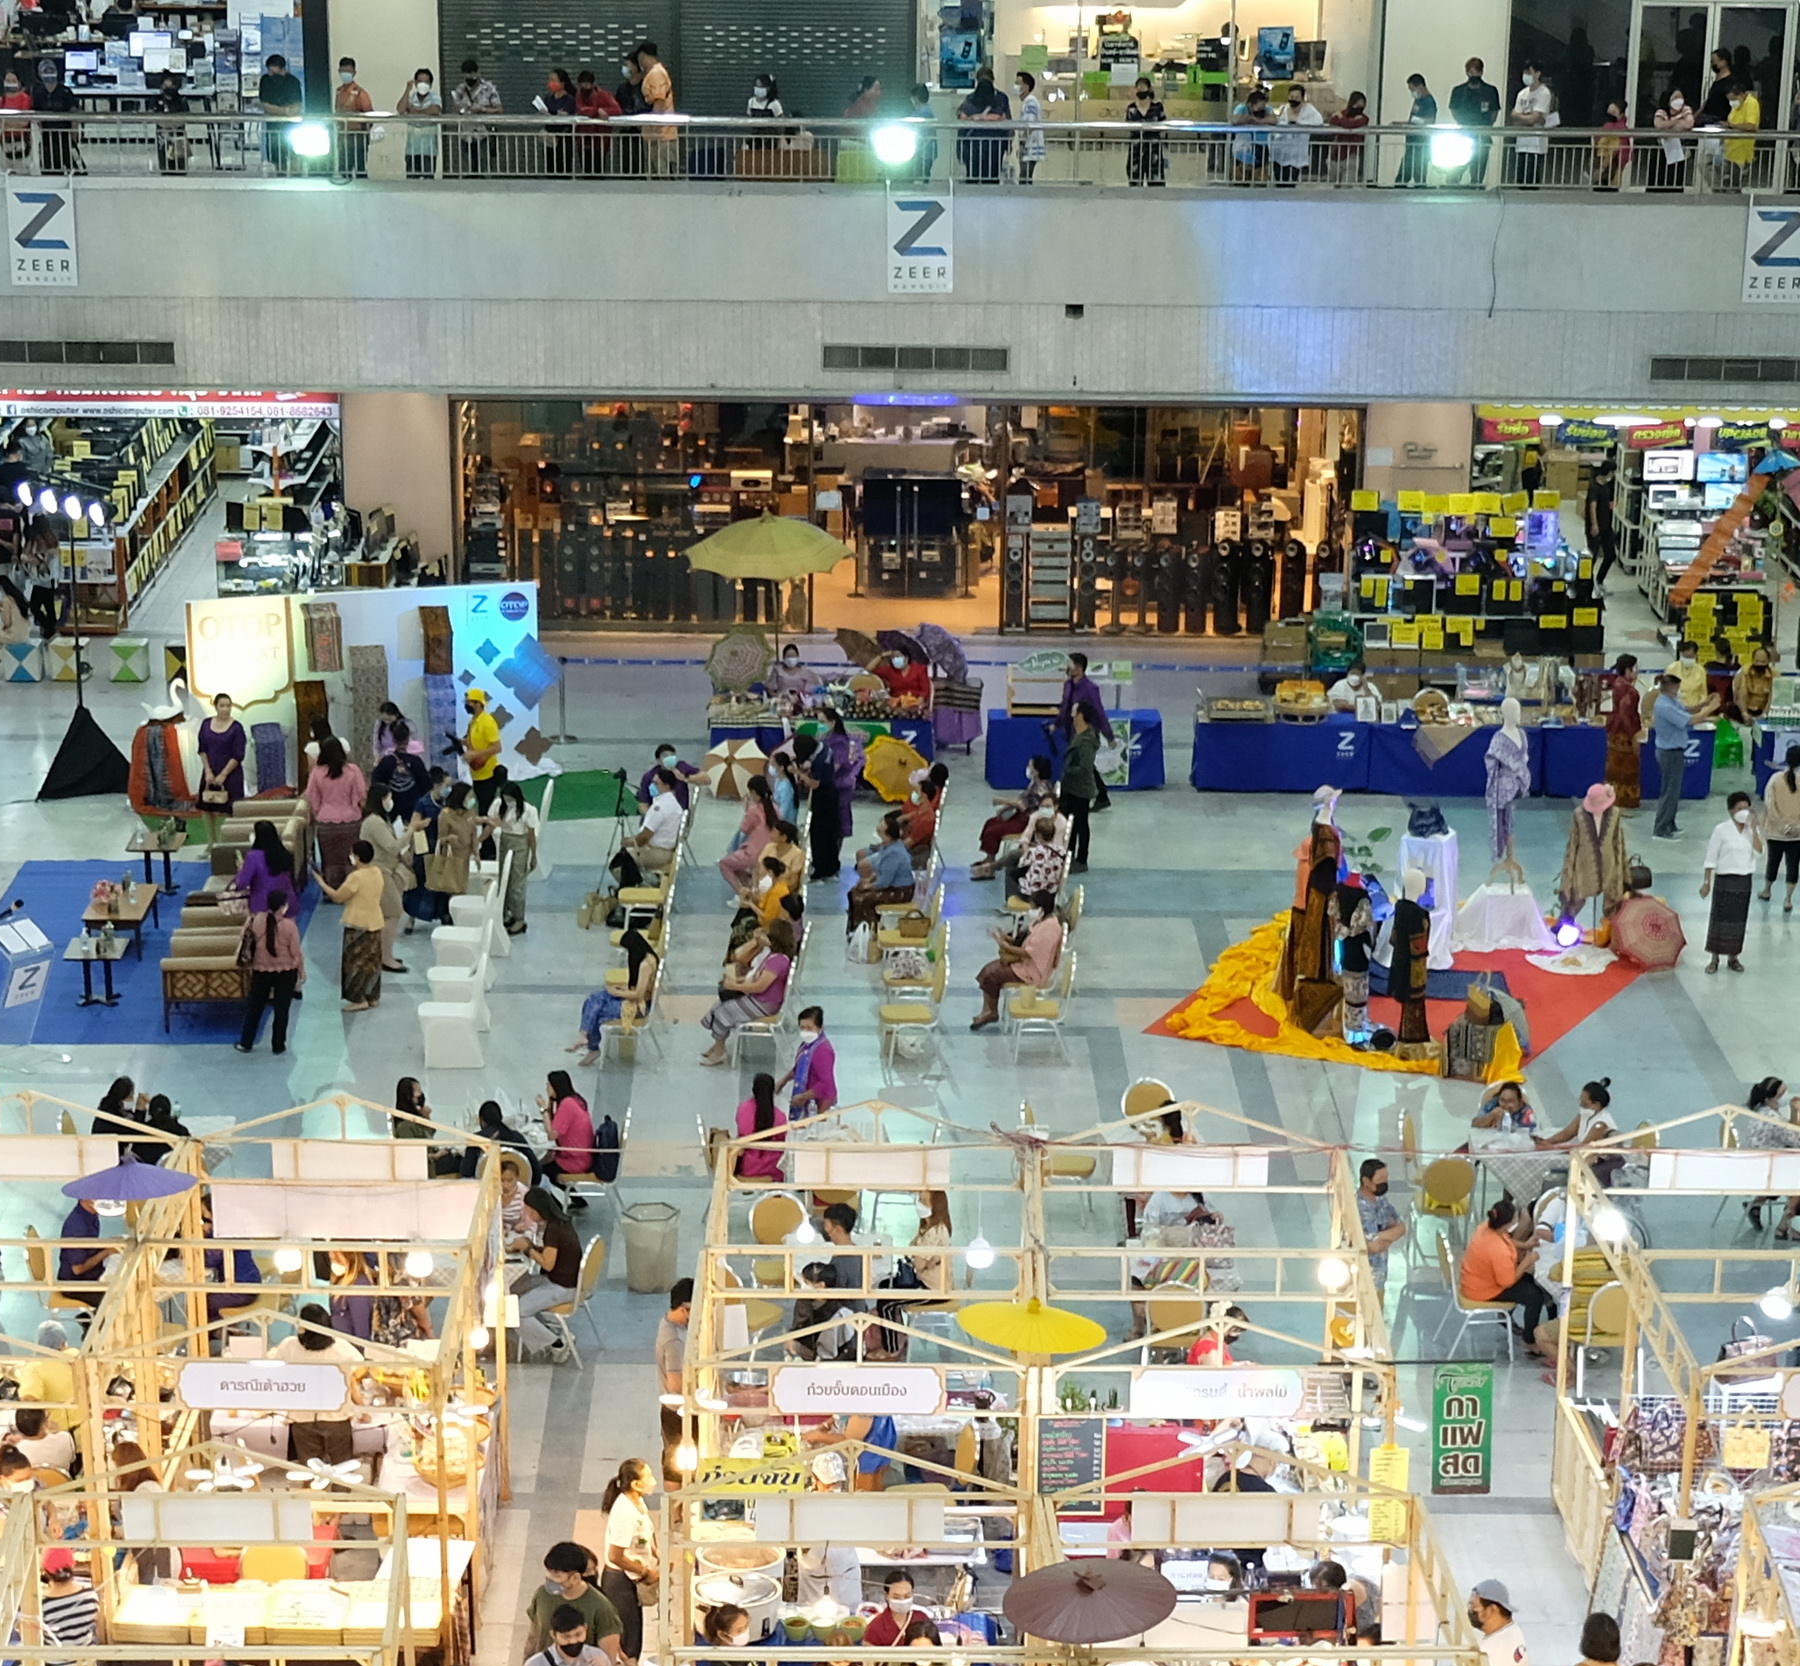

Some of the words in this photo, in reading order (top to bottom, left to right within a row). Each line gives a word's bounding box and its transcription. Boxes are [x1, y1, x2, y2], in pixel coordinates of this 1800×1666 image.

[16, 258, 70, 272] ZEER
[893, 266, 947, 279] ZEER
[18, 965, 41, 991] Z
[1444, 1396, 1481, 1420] กา
[1440, 1419, 1486, 1449] แฟ
[1439, 1450, 1484, 1479] สด
